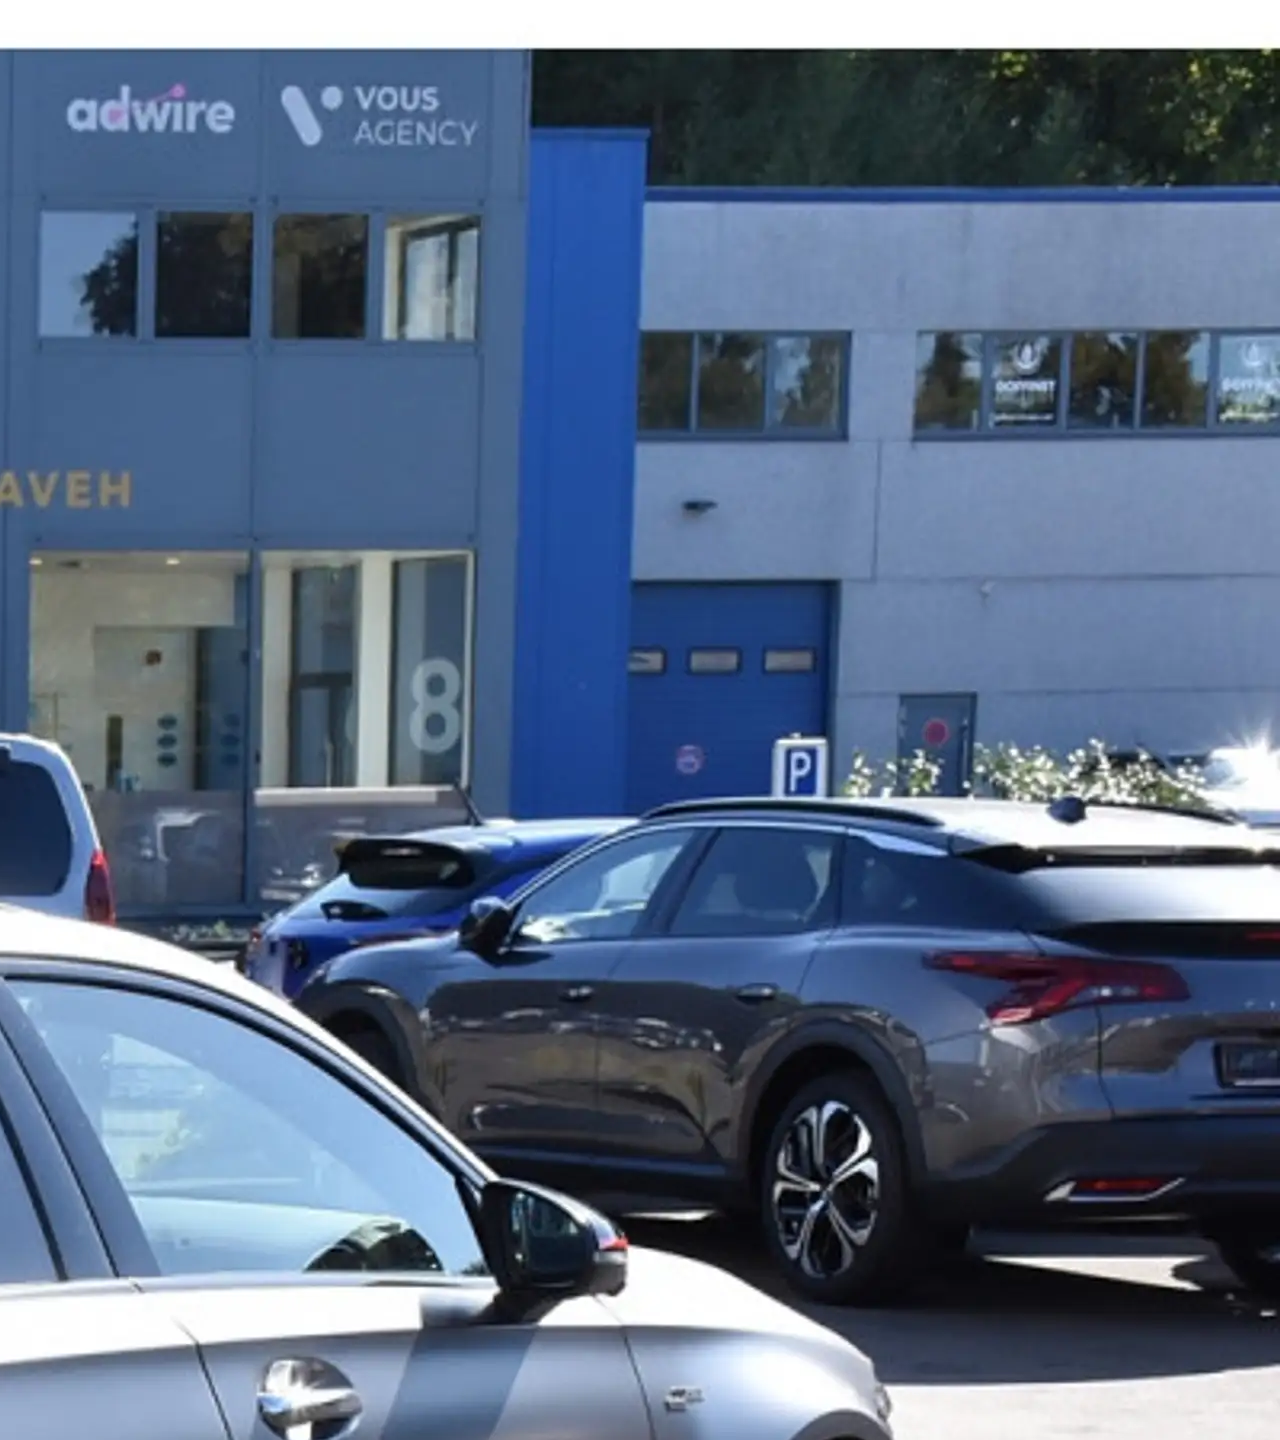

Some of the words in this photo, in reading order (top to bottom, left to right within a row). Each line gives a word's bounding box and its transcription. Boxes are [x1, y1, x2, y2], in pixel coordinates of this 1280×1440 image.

[66, 84, 236, 133] adwire
[354, 86, 440, 112] VOUS
[354, 119, 478, 146] AGENCY
[409, 658, 461, 754] 8
[789, 750, 812, 793] P
